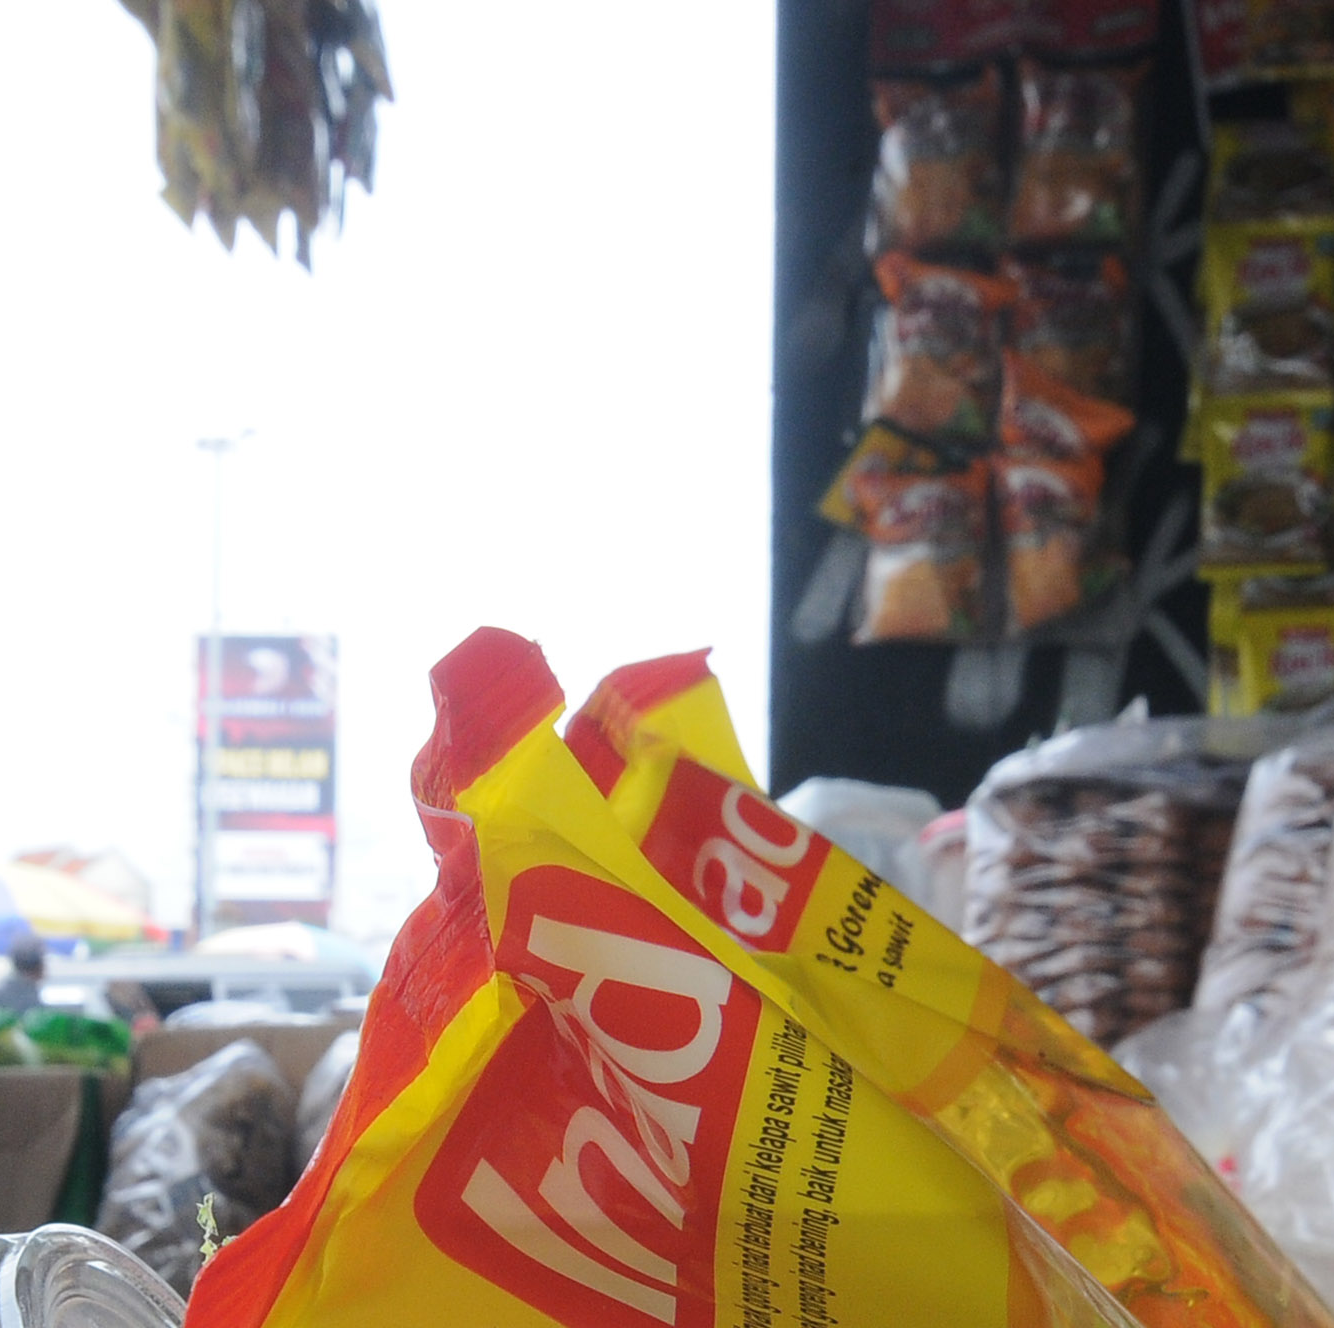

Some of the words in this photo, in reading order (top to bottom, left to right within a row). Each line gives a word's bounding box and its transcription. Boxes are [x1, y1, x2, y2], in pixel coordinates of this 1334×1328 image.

[882, 911, 914, 970] sawit
[764, 1067, 801, 1116] sawit
[746, 1116, 797, 1175] kelapa
[812, 1115, 847, 1165] untuk
[741, 1170, 778, 1205] dari
[796, 1167, 837, 1204] baik
[735, 1200, 774, 1248] terbuat
[792, 1206, 840, 1257] bening,
[733, 1242, 769, 1279] inad
[789, 1246, 826, 1289] inad
[742, 1274, 782, 1316] goreng
[799, 1285, 838, 1325] goreng
